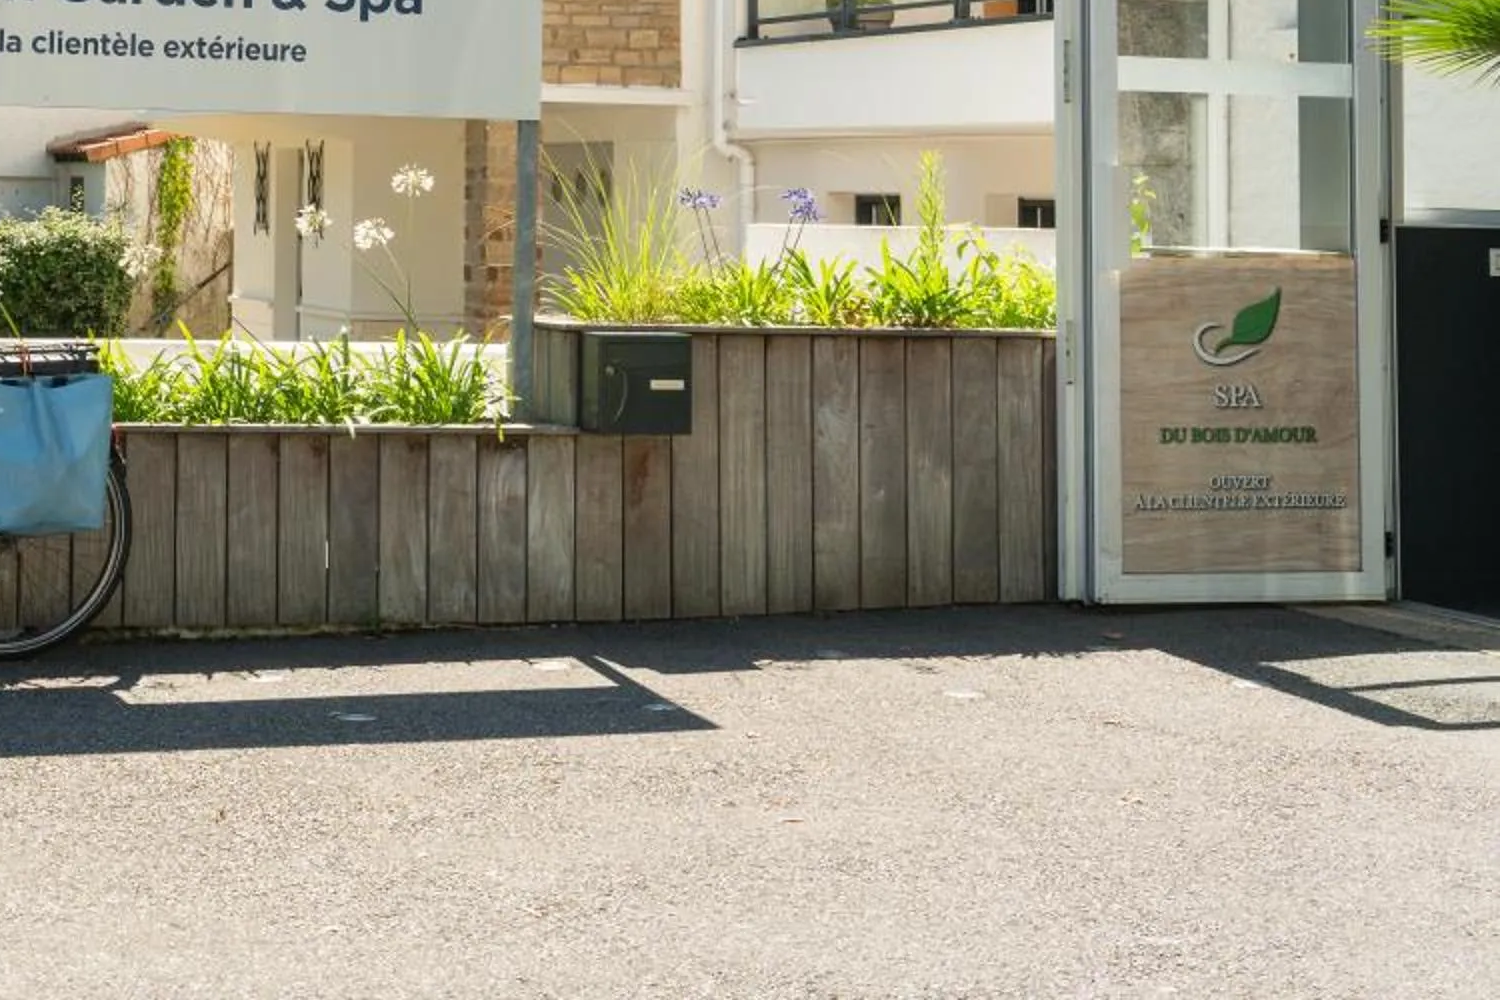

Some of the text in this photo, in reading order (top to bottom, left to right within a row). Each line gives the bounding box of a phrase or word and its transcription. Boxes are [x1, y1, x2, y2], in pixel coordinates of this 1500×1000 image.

[31, 29, 155, 58] clientèle
[163, 35, 307, 63] extérieure
[1214, 385, 1263, 409] SPA
[1160, 426, 1317, 444] DU BOIS D'AMOUR
[1210, 475, 1271, 489] OUVERT
